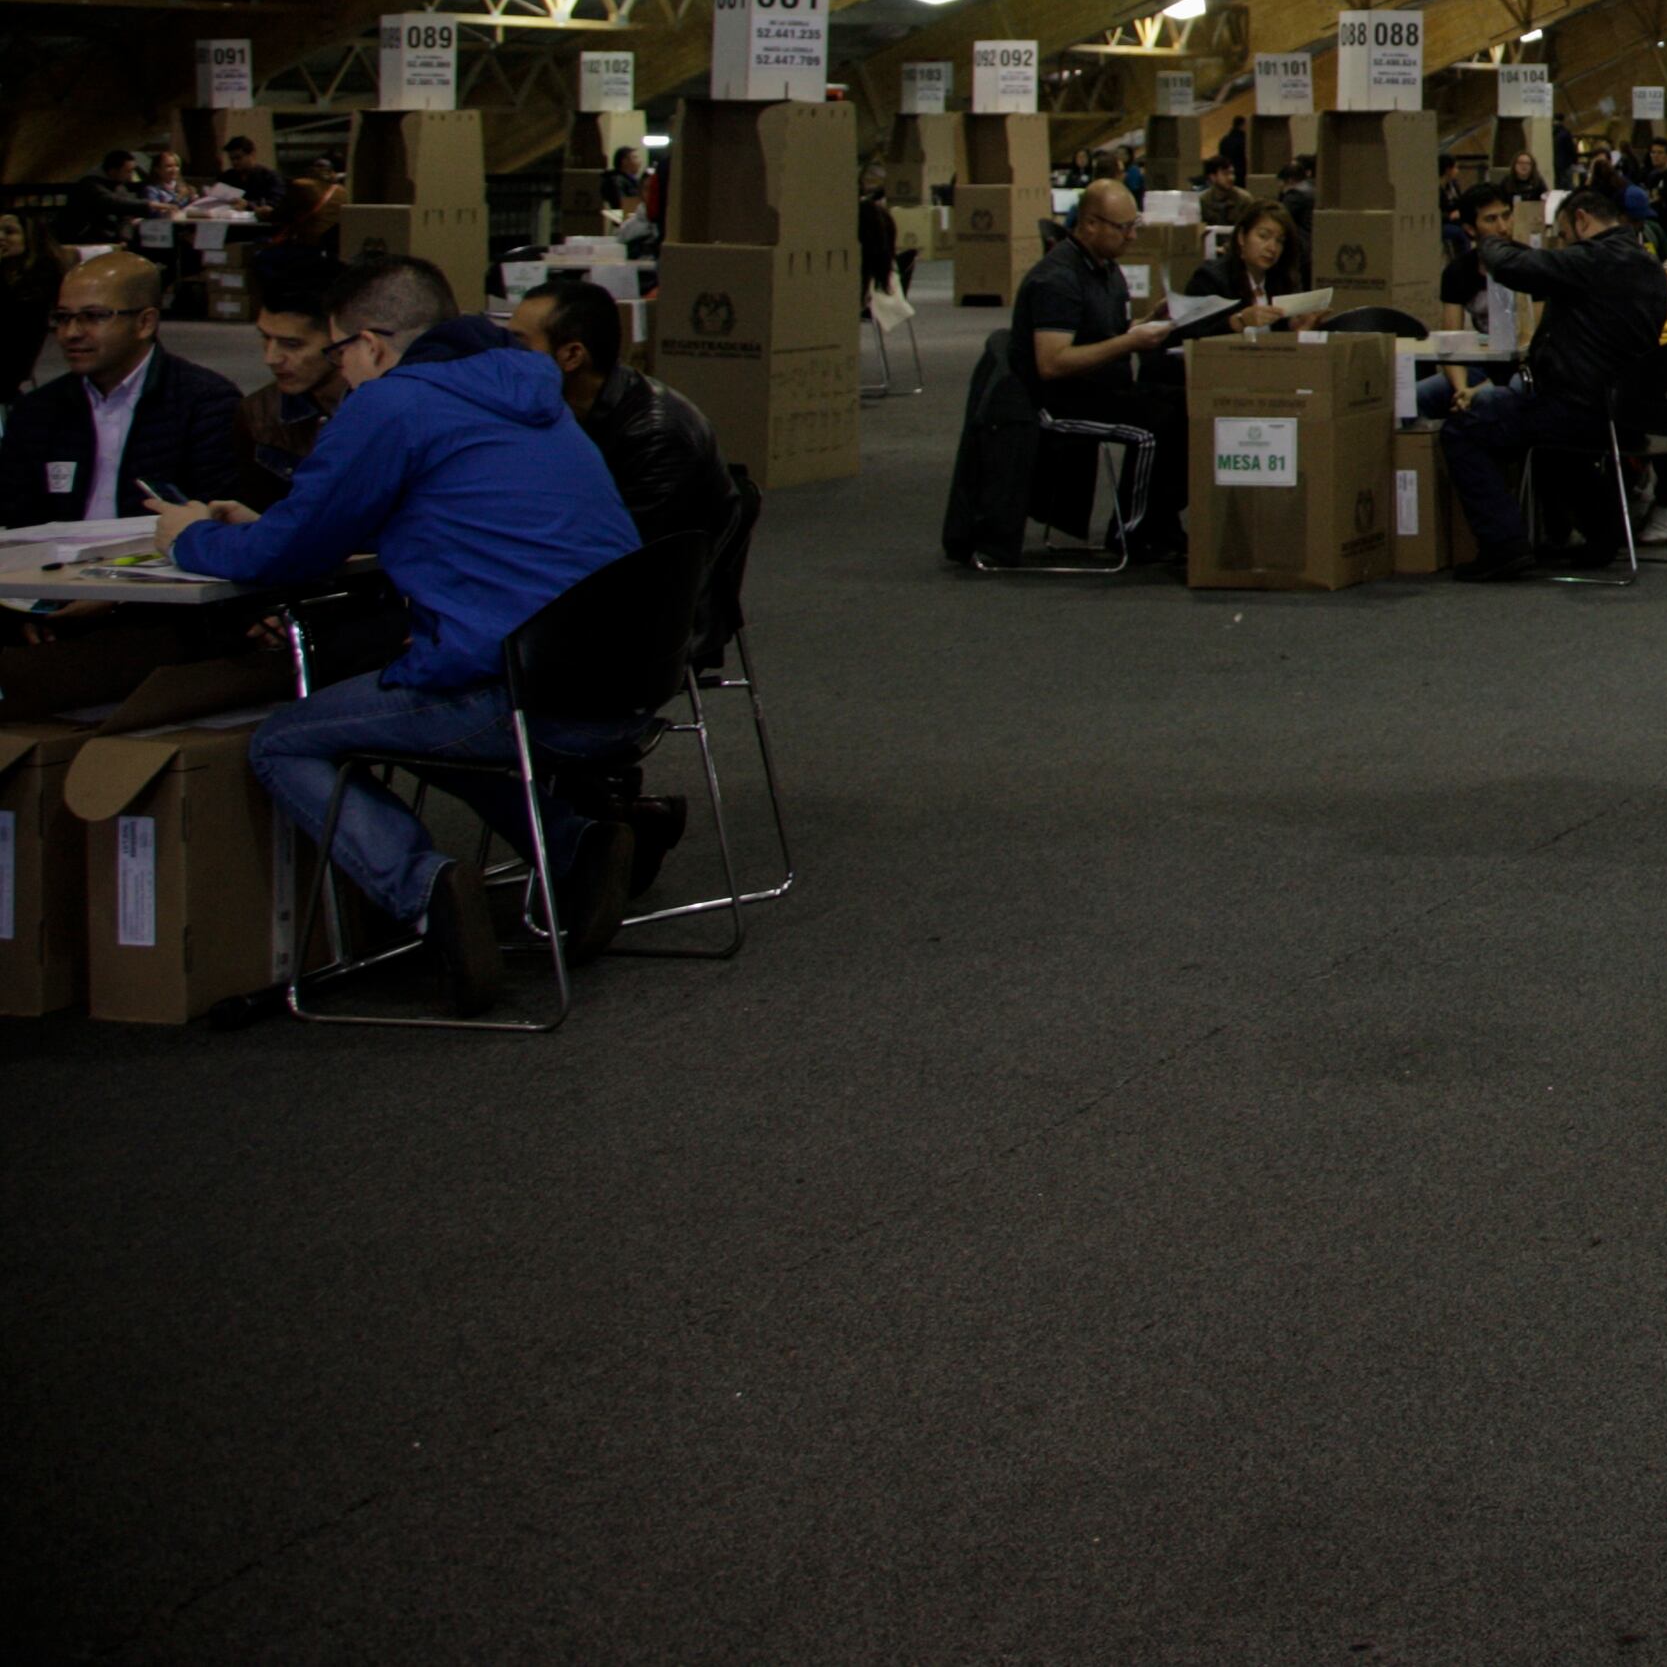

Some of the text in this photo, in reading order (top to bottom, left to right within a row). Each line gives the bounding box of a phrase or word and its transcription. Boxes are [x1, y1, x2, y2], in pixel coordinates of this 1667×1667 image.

[407, 25, 453, 49] 089
[1374, 22, 1419, 46] 088
[215, 48, 246, 65] 091
[1000, 49, 1034, 67] 092
[604, 59, 630, 73] 102
[1282, 60, 1308, 75] 101
[1523, 70, 1545, 83] 104
[1217, 454, 1286, 471] MESA 81
